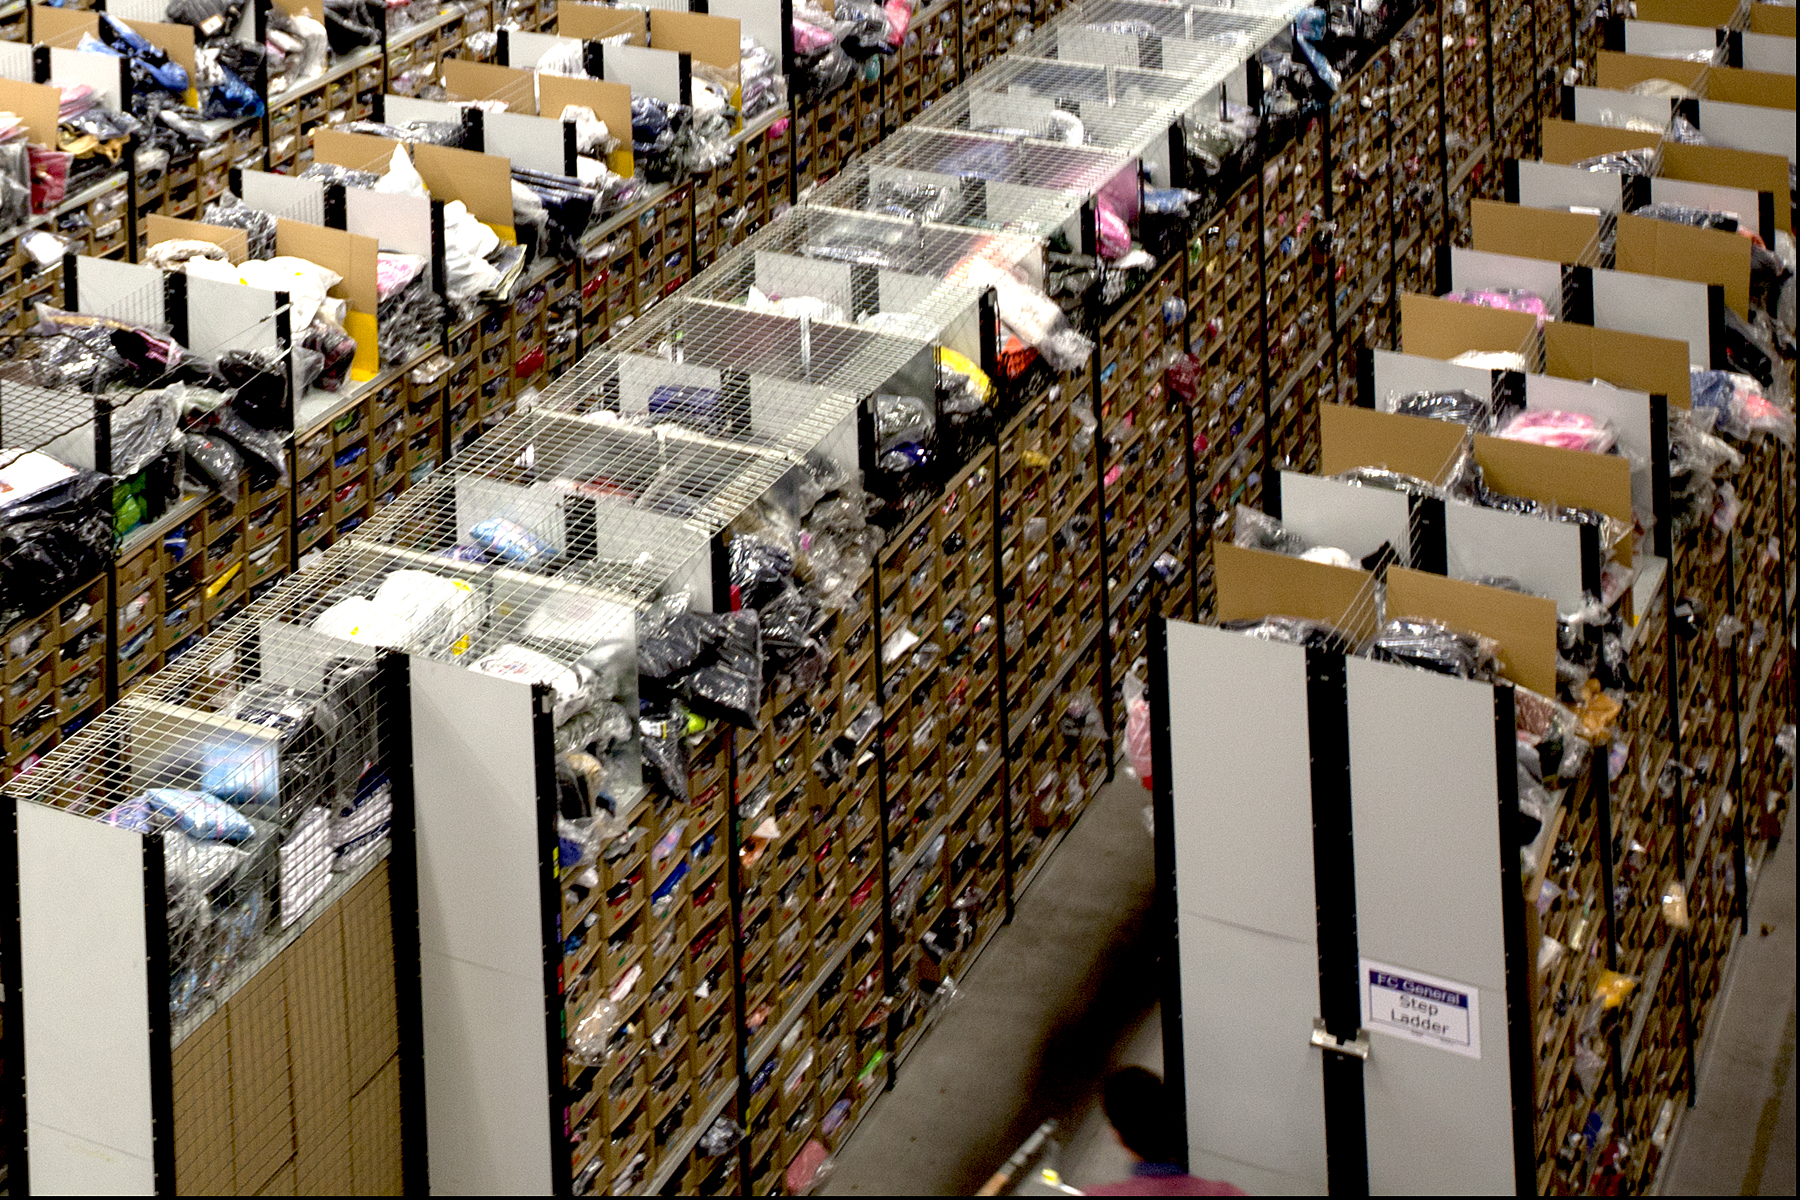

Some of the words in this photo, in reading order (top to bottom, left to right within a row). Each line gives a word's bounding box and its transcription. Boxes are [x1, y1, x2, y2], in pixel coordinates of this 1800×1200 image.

[1377, 973, 1399, 989] FC
[1402, 980, 1461, 1006] General
[1400, 994, 1439, 1016] Step
[1391, 1008, 1450, 1035] Ladder
